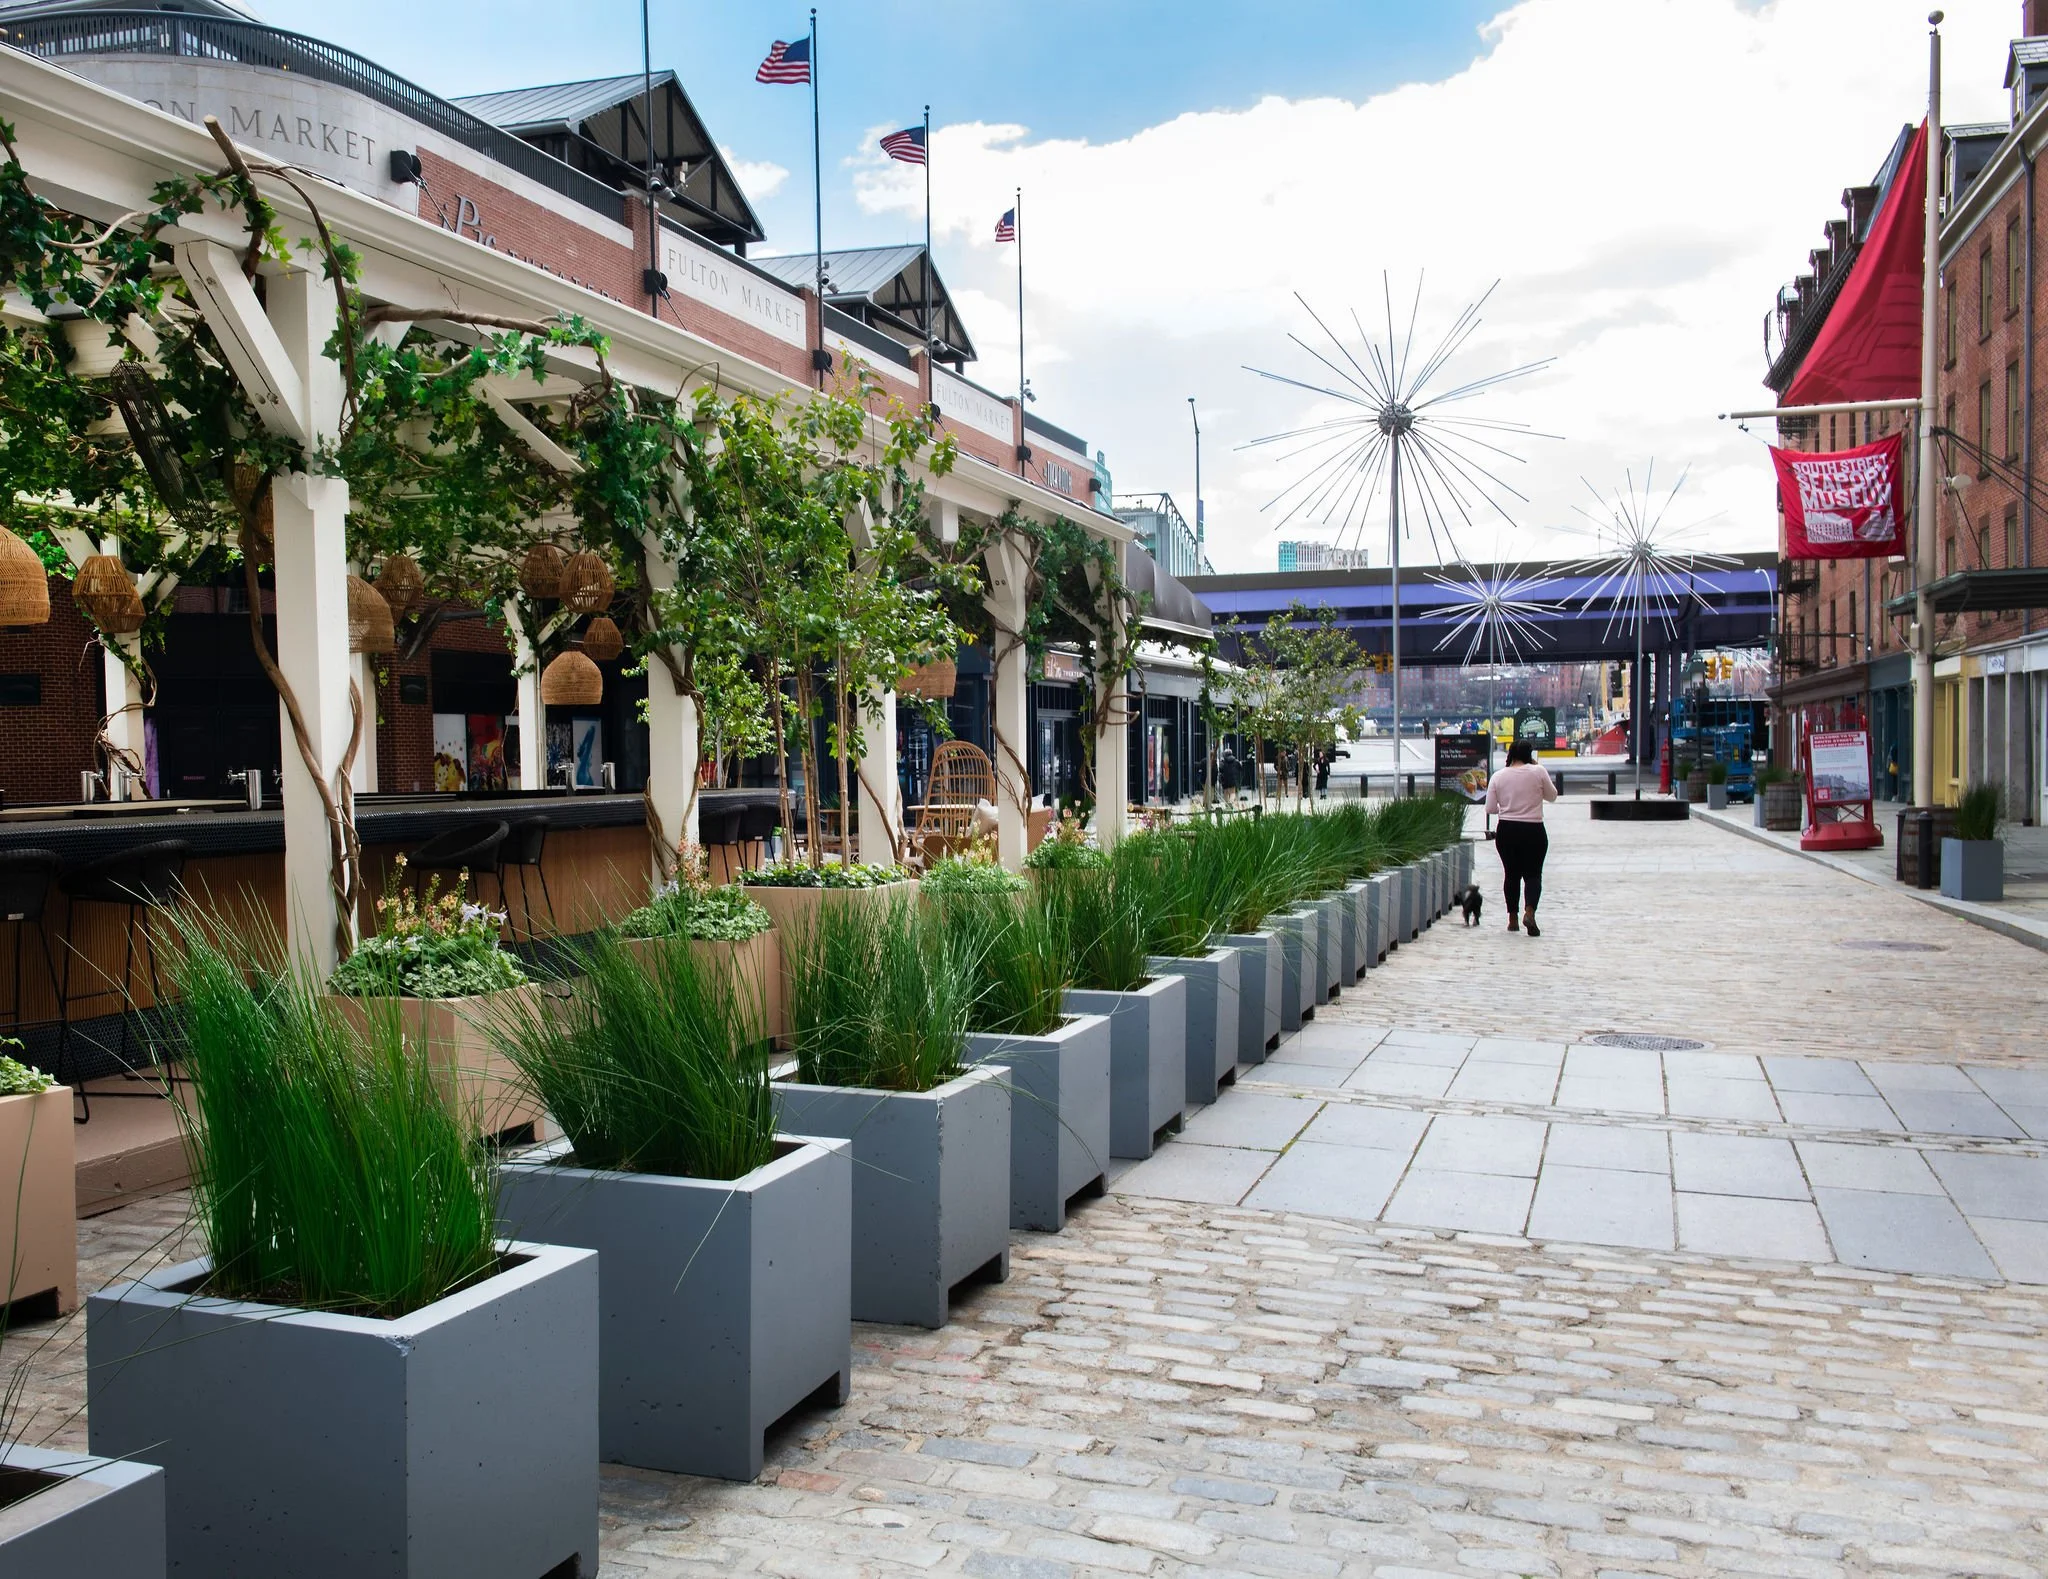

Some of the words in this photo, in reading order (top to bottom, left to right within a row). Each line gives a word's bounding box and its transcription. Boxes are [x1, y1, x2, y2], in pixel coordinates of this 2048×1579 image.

[229, 105, 376, 166] MARKET
[668, 248, 728, 297] FULTON
[742, 285, 801, 332] MARKET
[936, 383, 970, 413] FULTON
[975, 402, 1010, 432] MARKET
[1792, 460, 1838, 475] SOUTH
[1840, 452, 1888, 473] STREET
[1796, 464, 1889, 492] SEAPORT
[1800, 482, 1892, 510] MUSEUM
